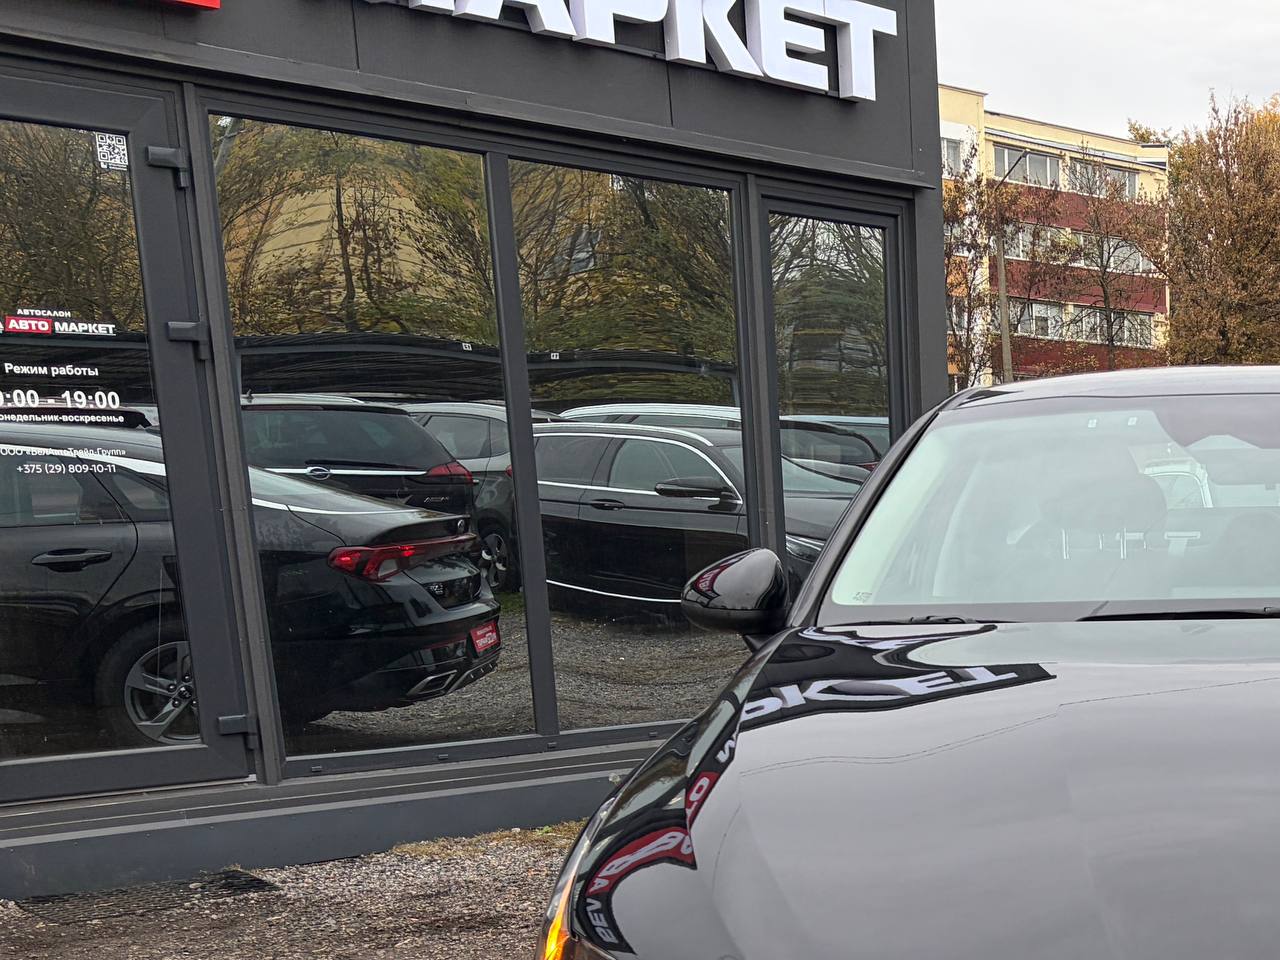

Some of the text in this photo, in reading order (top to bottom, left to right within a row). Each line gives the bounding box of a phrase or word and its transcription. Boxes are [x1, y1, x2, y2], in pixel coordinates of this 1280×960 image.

[405, 0, 898, 101] КЕТ
[17, 308, 71, 317] АВТОСАЛОН
[9, 319, 49, 331] АВТО
[54, 321, 116, 334] МАРКЕТ
[5, 363, 99, 377] Режим работы
[62, 390, 120, 409] 19:00
[0, 413, 125, 423] онедельник-воскресенье
[17, 464, 116, 474] +375 (29) 809-10-11
